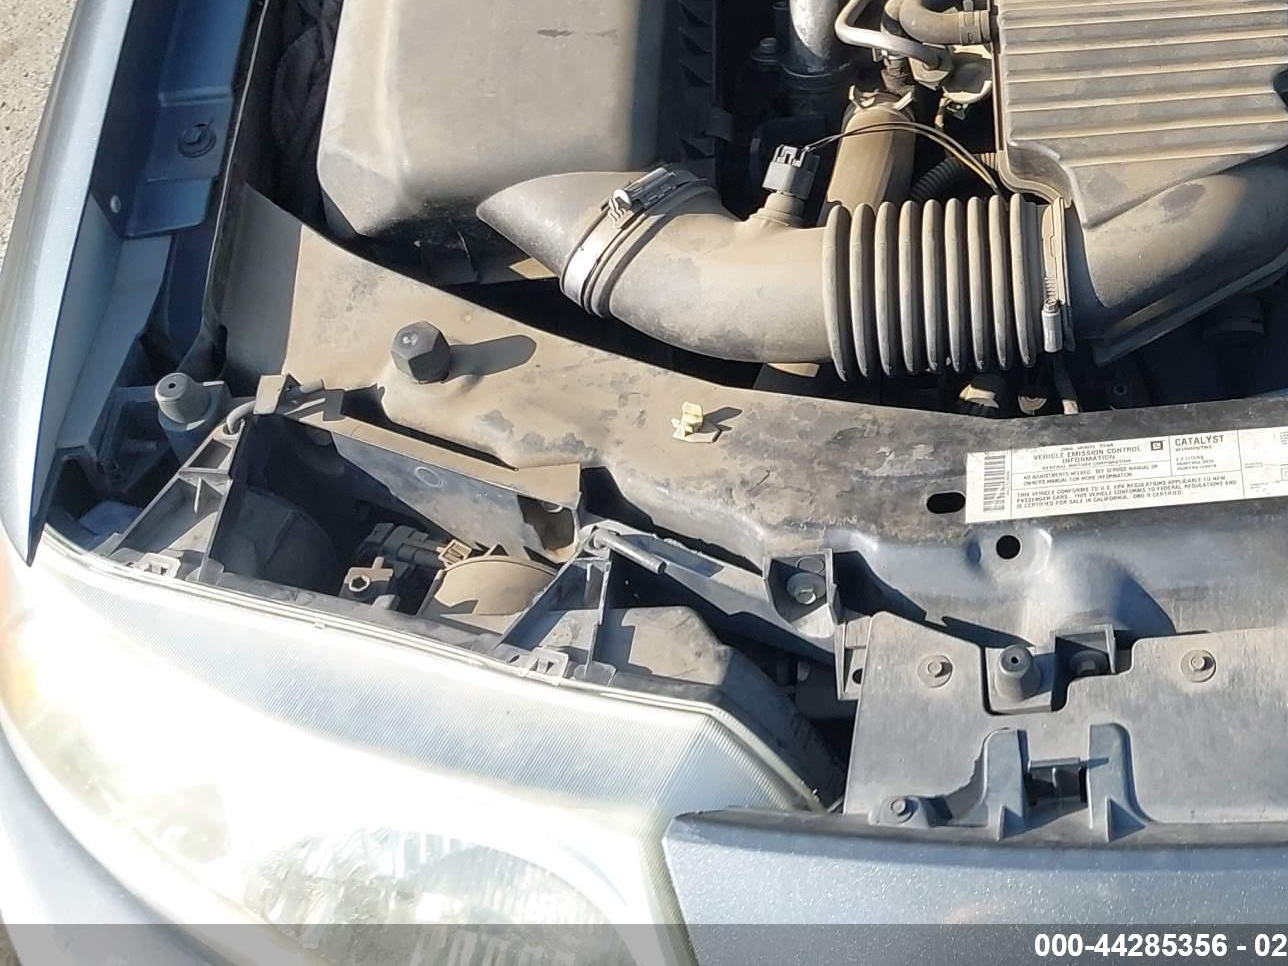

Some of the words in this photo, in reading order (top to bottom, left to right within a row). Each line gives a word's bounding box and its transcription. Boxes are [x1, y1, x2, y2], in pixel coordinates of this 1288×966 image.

[1175, 435, 1224, 446] CATALYST
[1033, 451, 1063, 460] VEHICLE
[1067, 449, 1103, 457] EMISSION
[1107, 446, 1140, 454] CONTROL
[1062, 454, 1114, 463] INFORMATION
